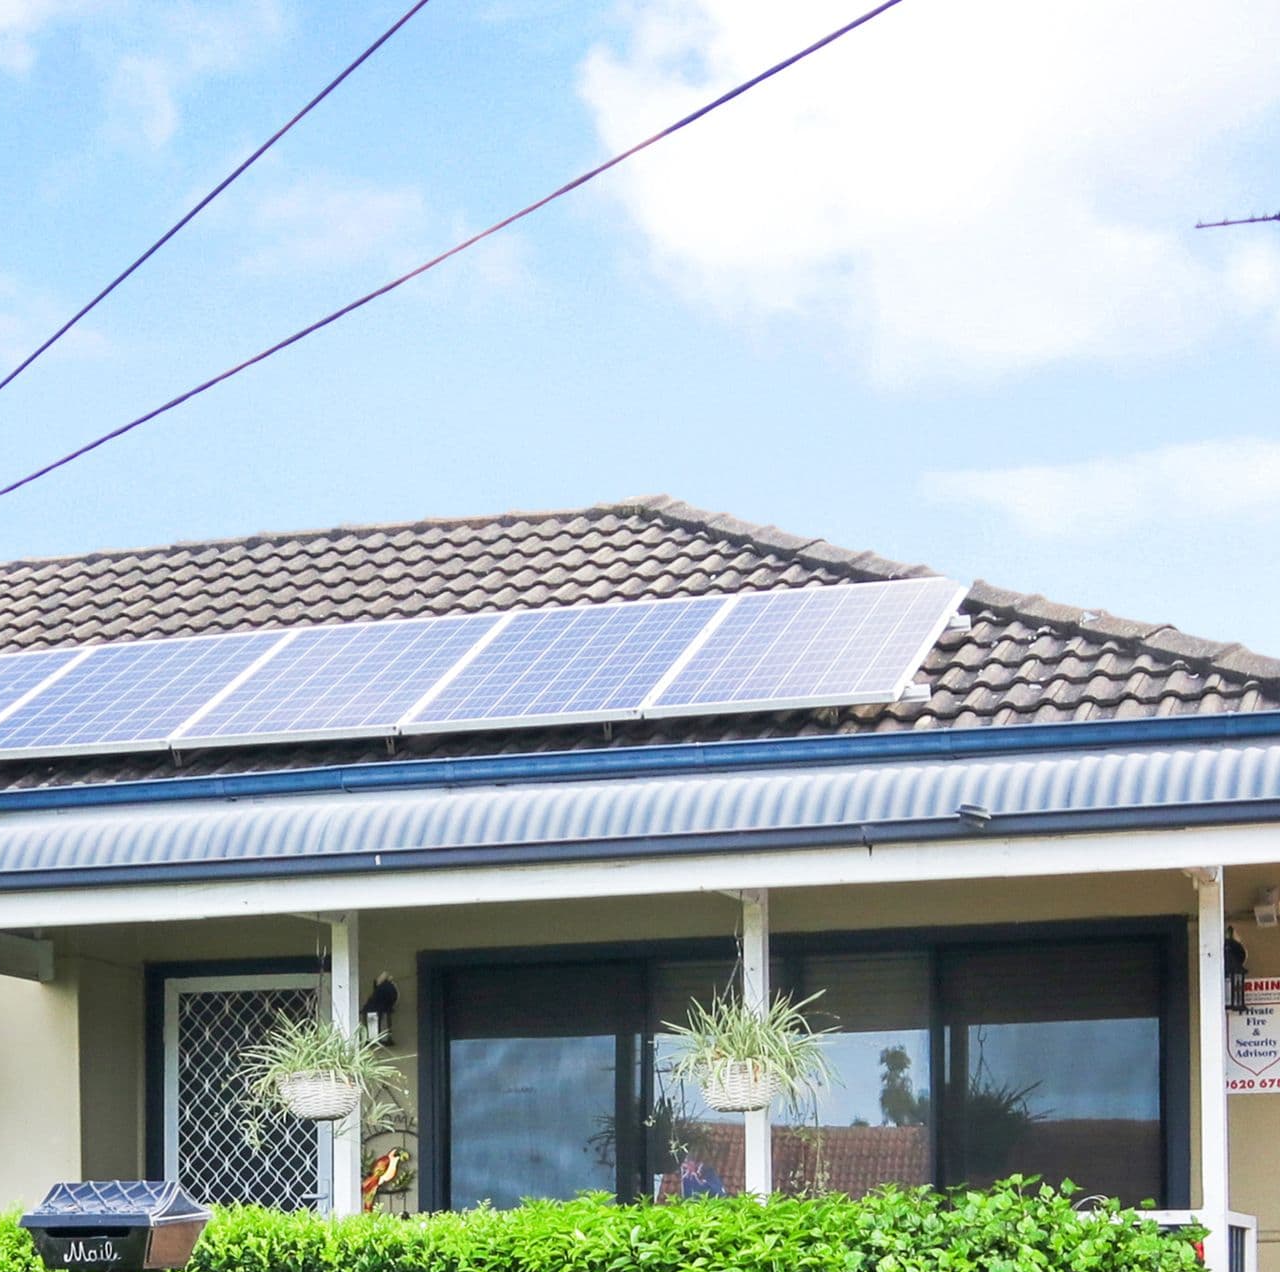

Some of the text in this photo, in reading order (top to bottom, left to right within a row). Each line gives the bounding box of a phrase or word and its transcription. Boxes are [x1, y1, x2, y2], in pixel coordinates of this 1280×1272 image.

[1247, 1017, 1267, 1026] Fire
[1252, 1028, 1261, 1036] &
[1235, 1038, 1277, 1047] Security
[1235, 1049, 1277, 1058] Advisory
[63, 1240, 120, 1263] Mail
